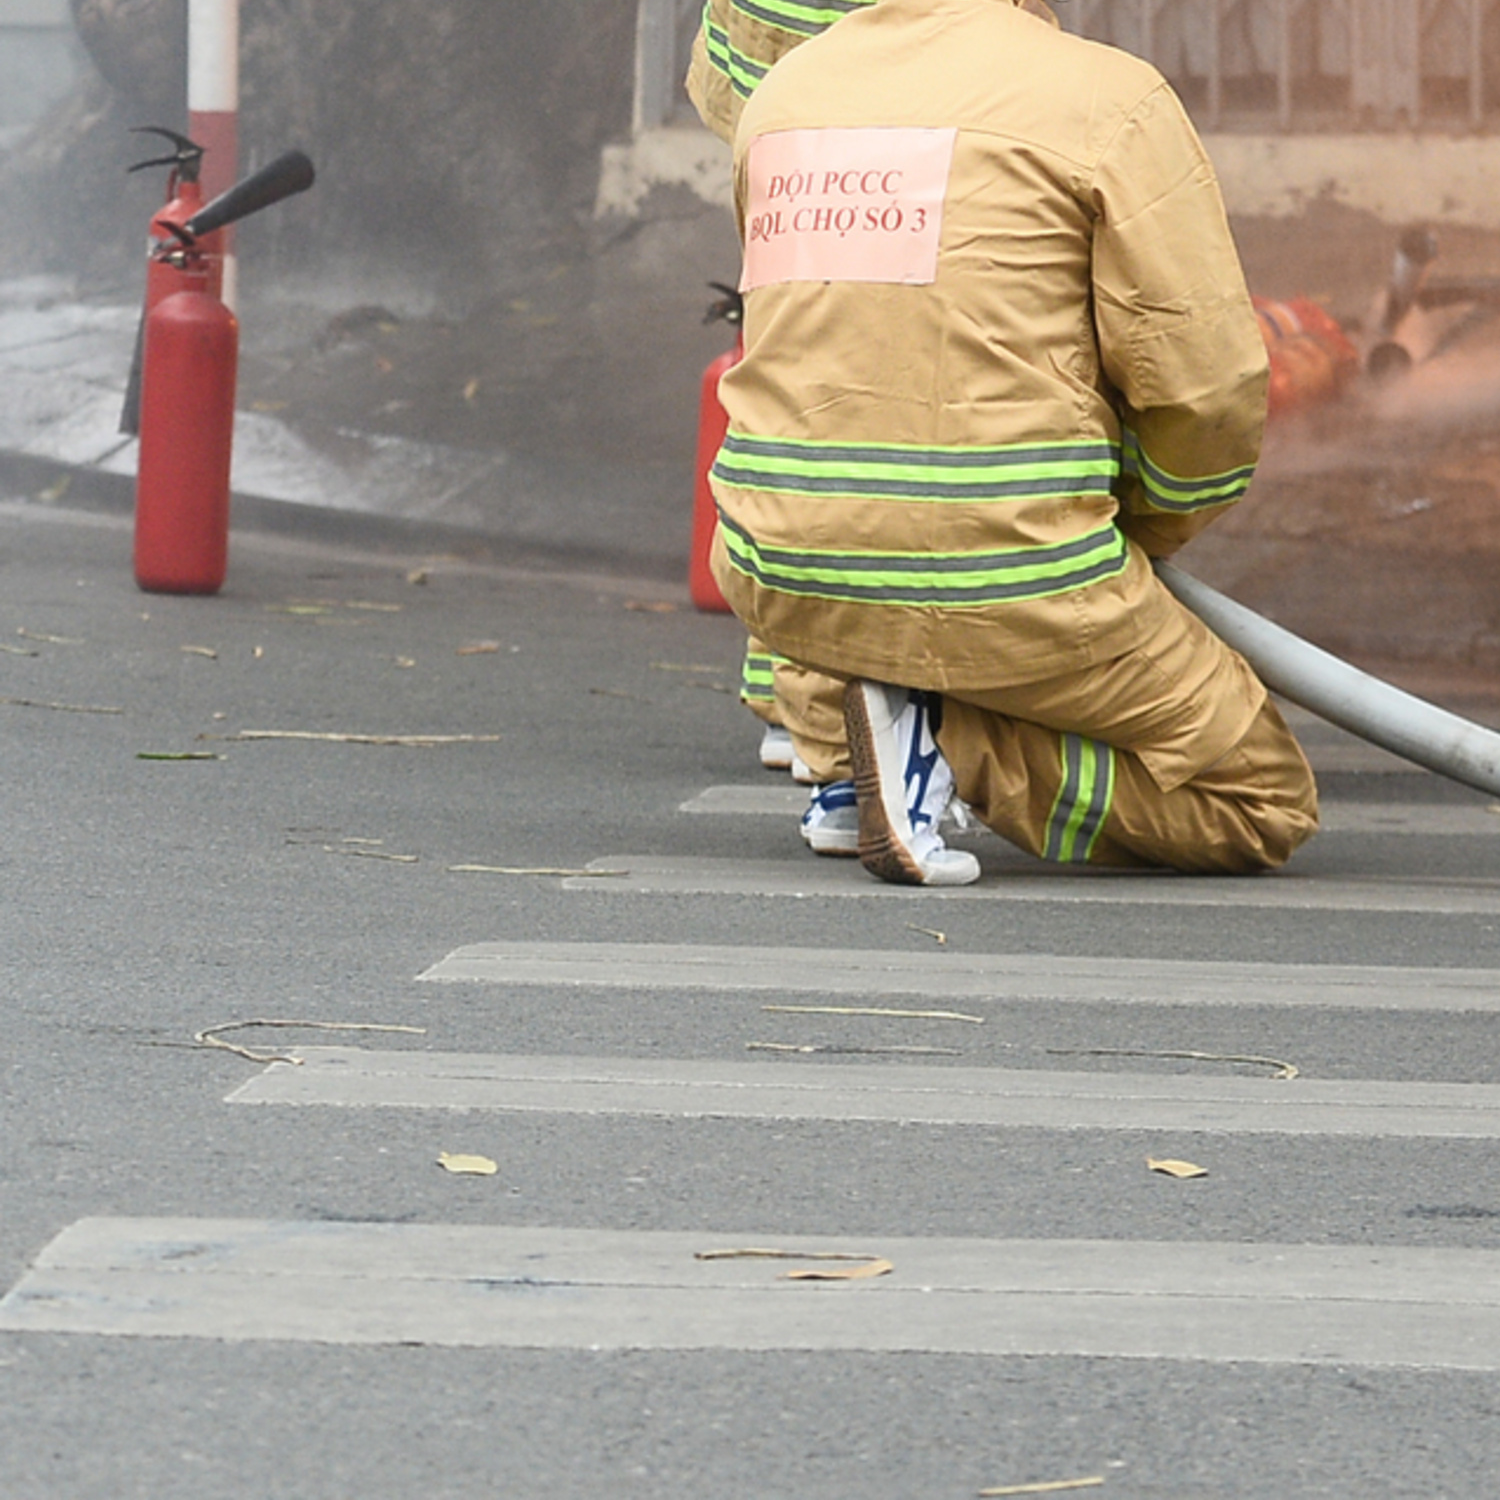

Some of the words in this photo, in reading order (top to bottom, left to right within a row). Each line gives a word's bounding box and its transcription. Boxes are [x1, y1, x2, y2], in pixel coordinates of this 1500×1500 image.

[768, 170, 815, 202] ĐỘI
[821, 170, 904, 196] PCCC
[750, 211, 787, 243] BQL
[792, 206, 859, 238] CHỢ
[910, 208, 927, 234] 3
